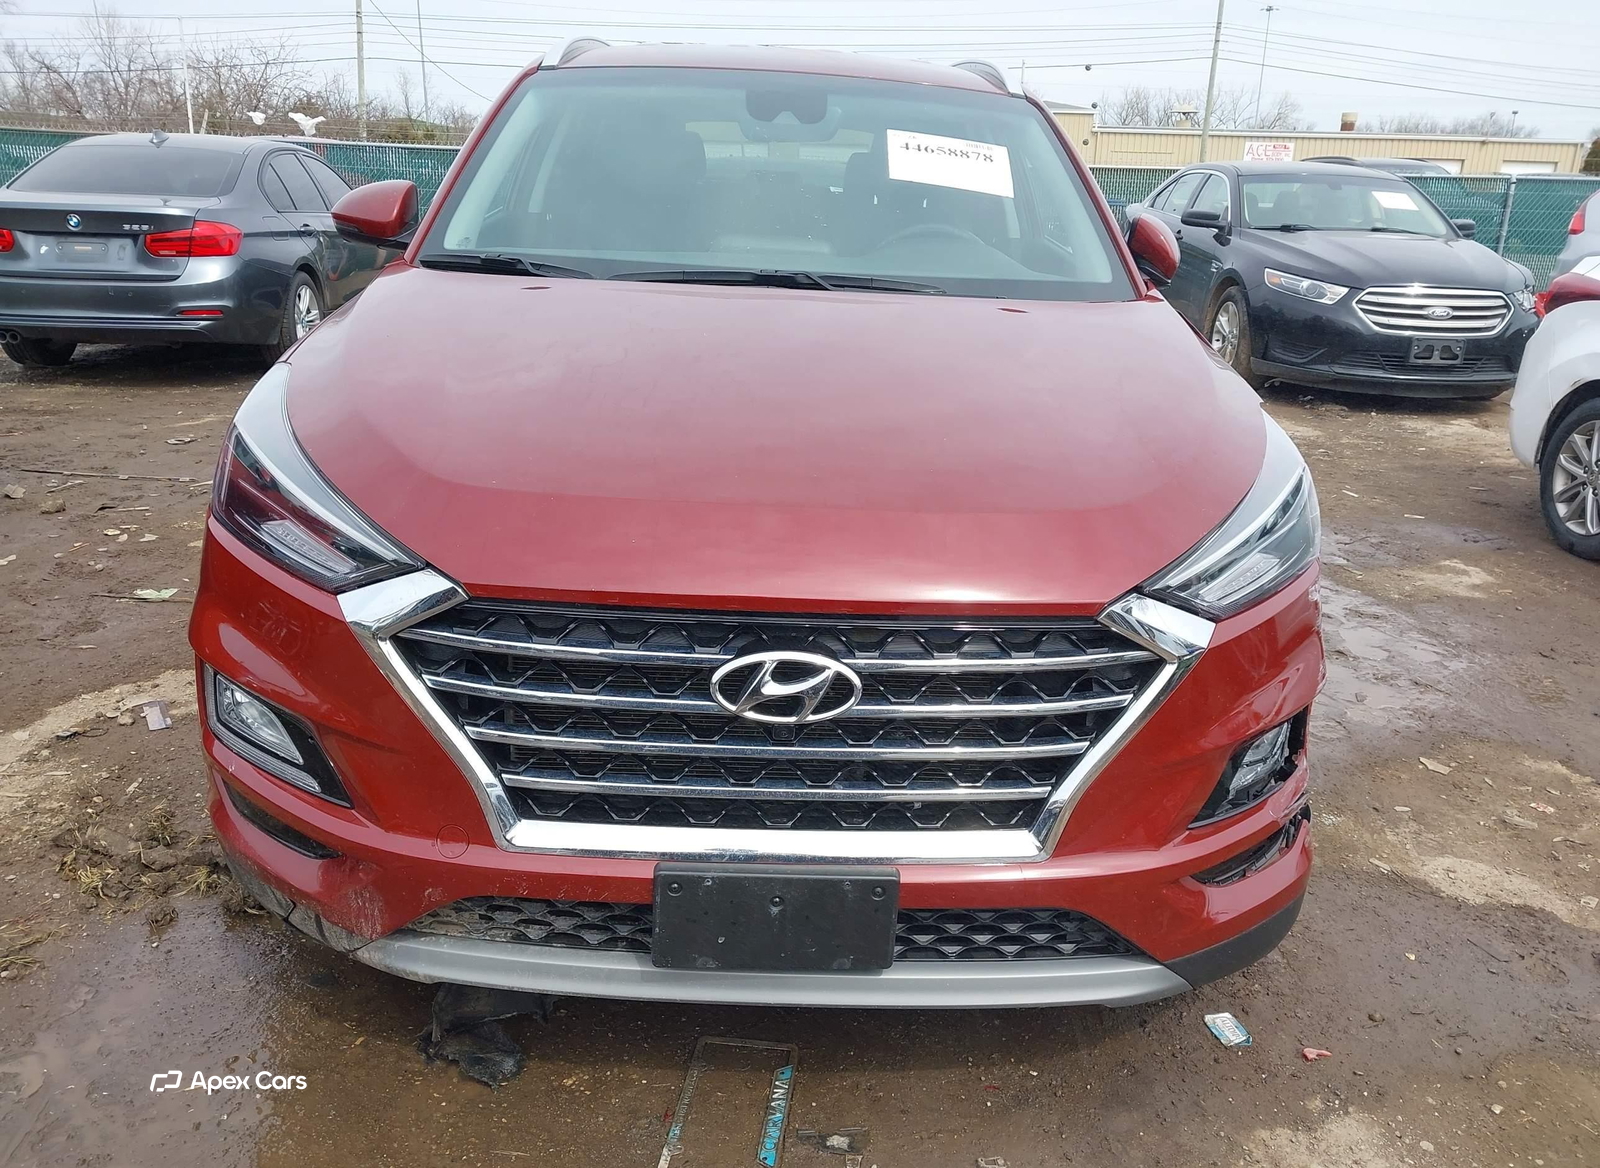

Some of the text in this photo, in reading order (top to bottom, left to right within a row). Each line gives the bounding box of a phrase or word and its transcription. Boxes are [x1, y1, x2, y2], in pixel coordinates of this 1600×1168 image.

[899, 142, 994, 162] 44658878
[1246, 144, 1271, 157] ACE
[1218, 1018, 1242, 1038] ALTOID
[761, 1078, 791, 1152] CARVANA
